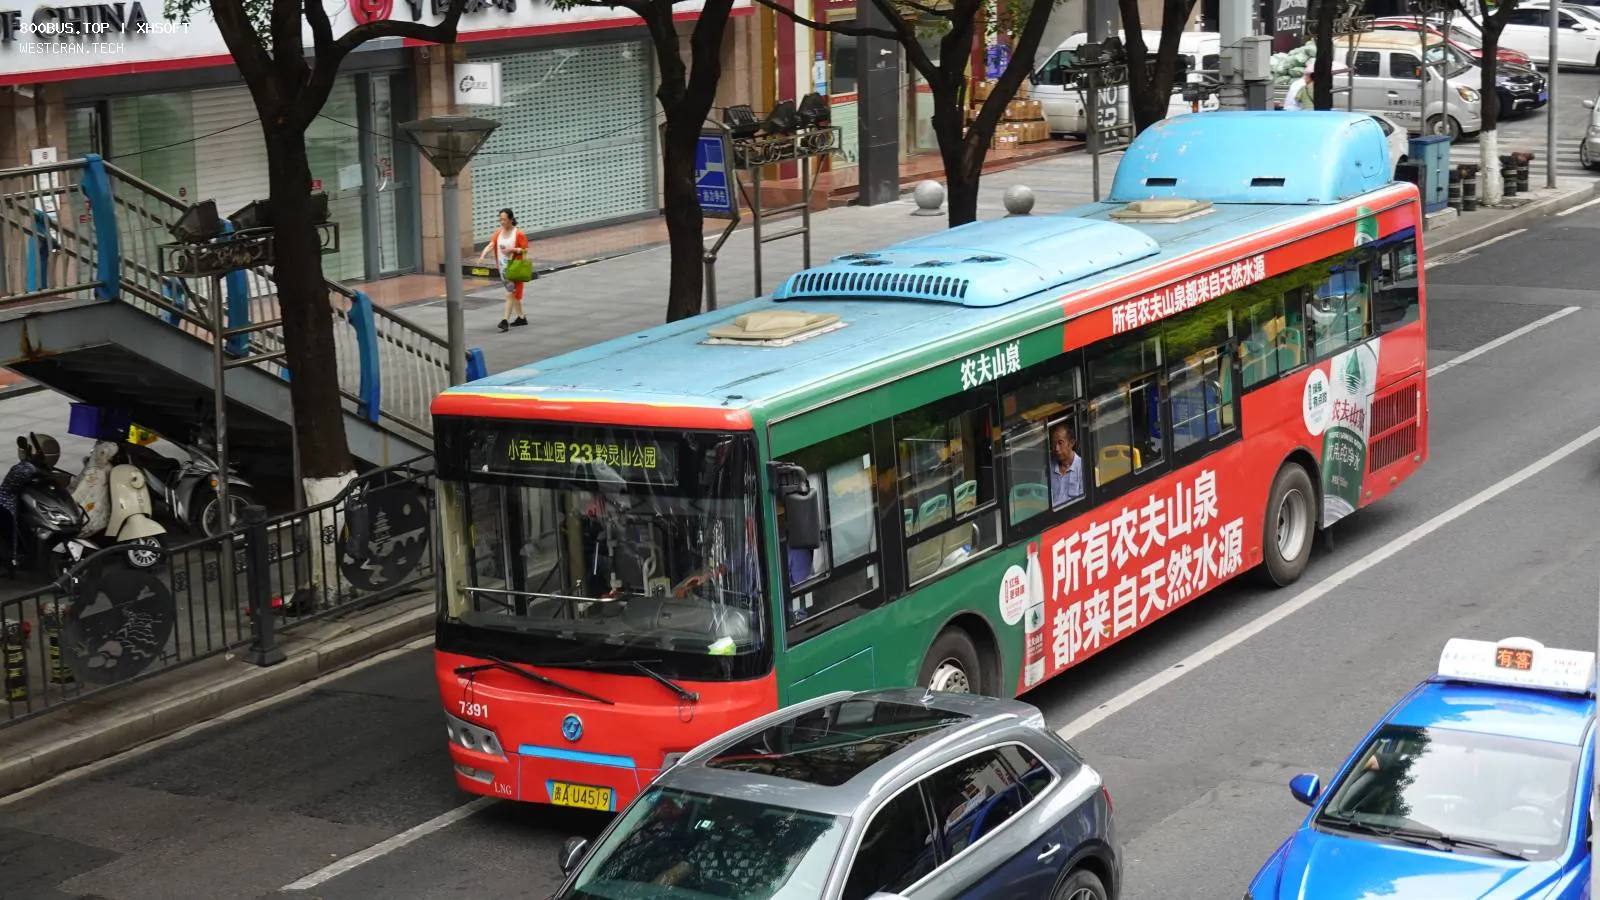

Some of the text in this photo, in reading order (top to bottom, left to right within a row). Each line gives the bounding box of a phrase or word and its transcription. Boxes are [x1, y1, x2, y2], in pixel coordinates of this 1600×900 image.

[32, 1, 148, 38] CHINA
[1111, 254, 1266, 335] 所有农夫山泉都来自天然水源
[960, 343, 1022, 391] 农夫山泉
[508, 439, 656, 468] 小孟工业园 23 黔灵山公园
[1051, 469, 1219, 602] 所有农夫山泉
[1051, 516, 1244, 671] 都来自天然水源
[1497, 649, 1531, 671] 有客
[458, 701, 488, 718] 7391
[494, 782, 512, 795] LNG
